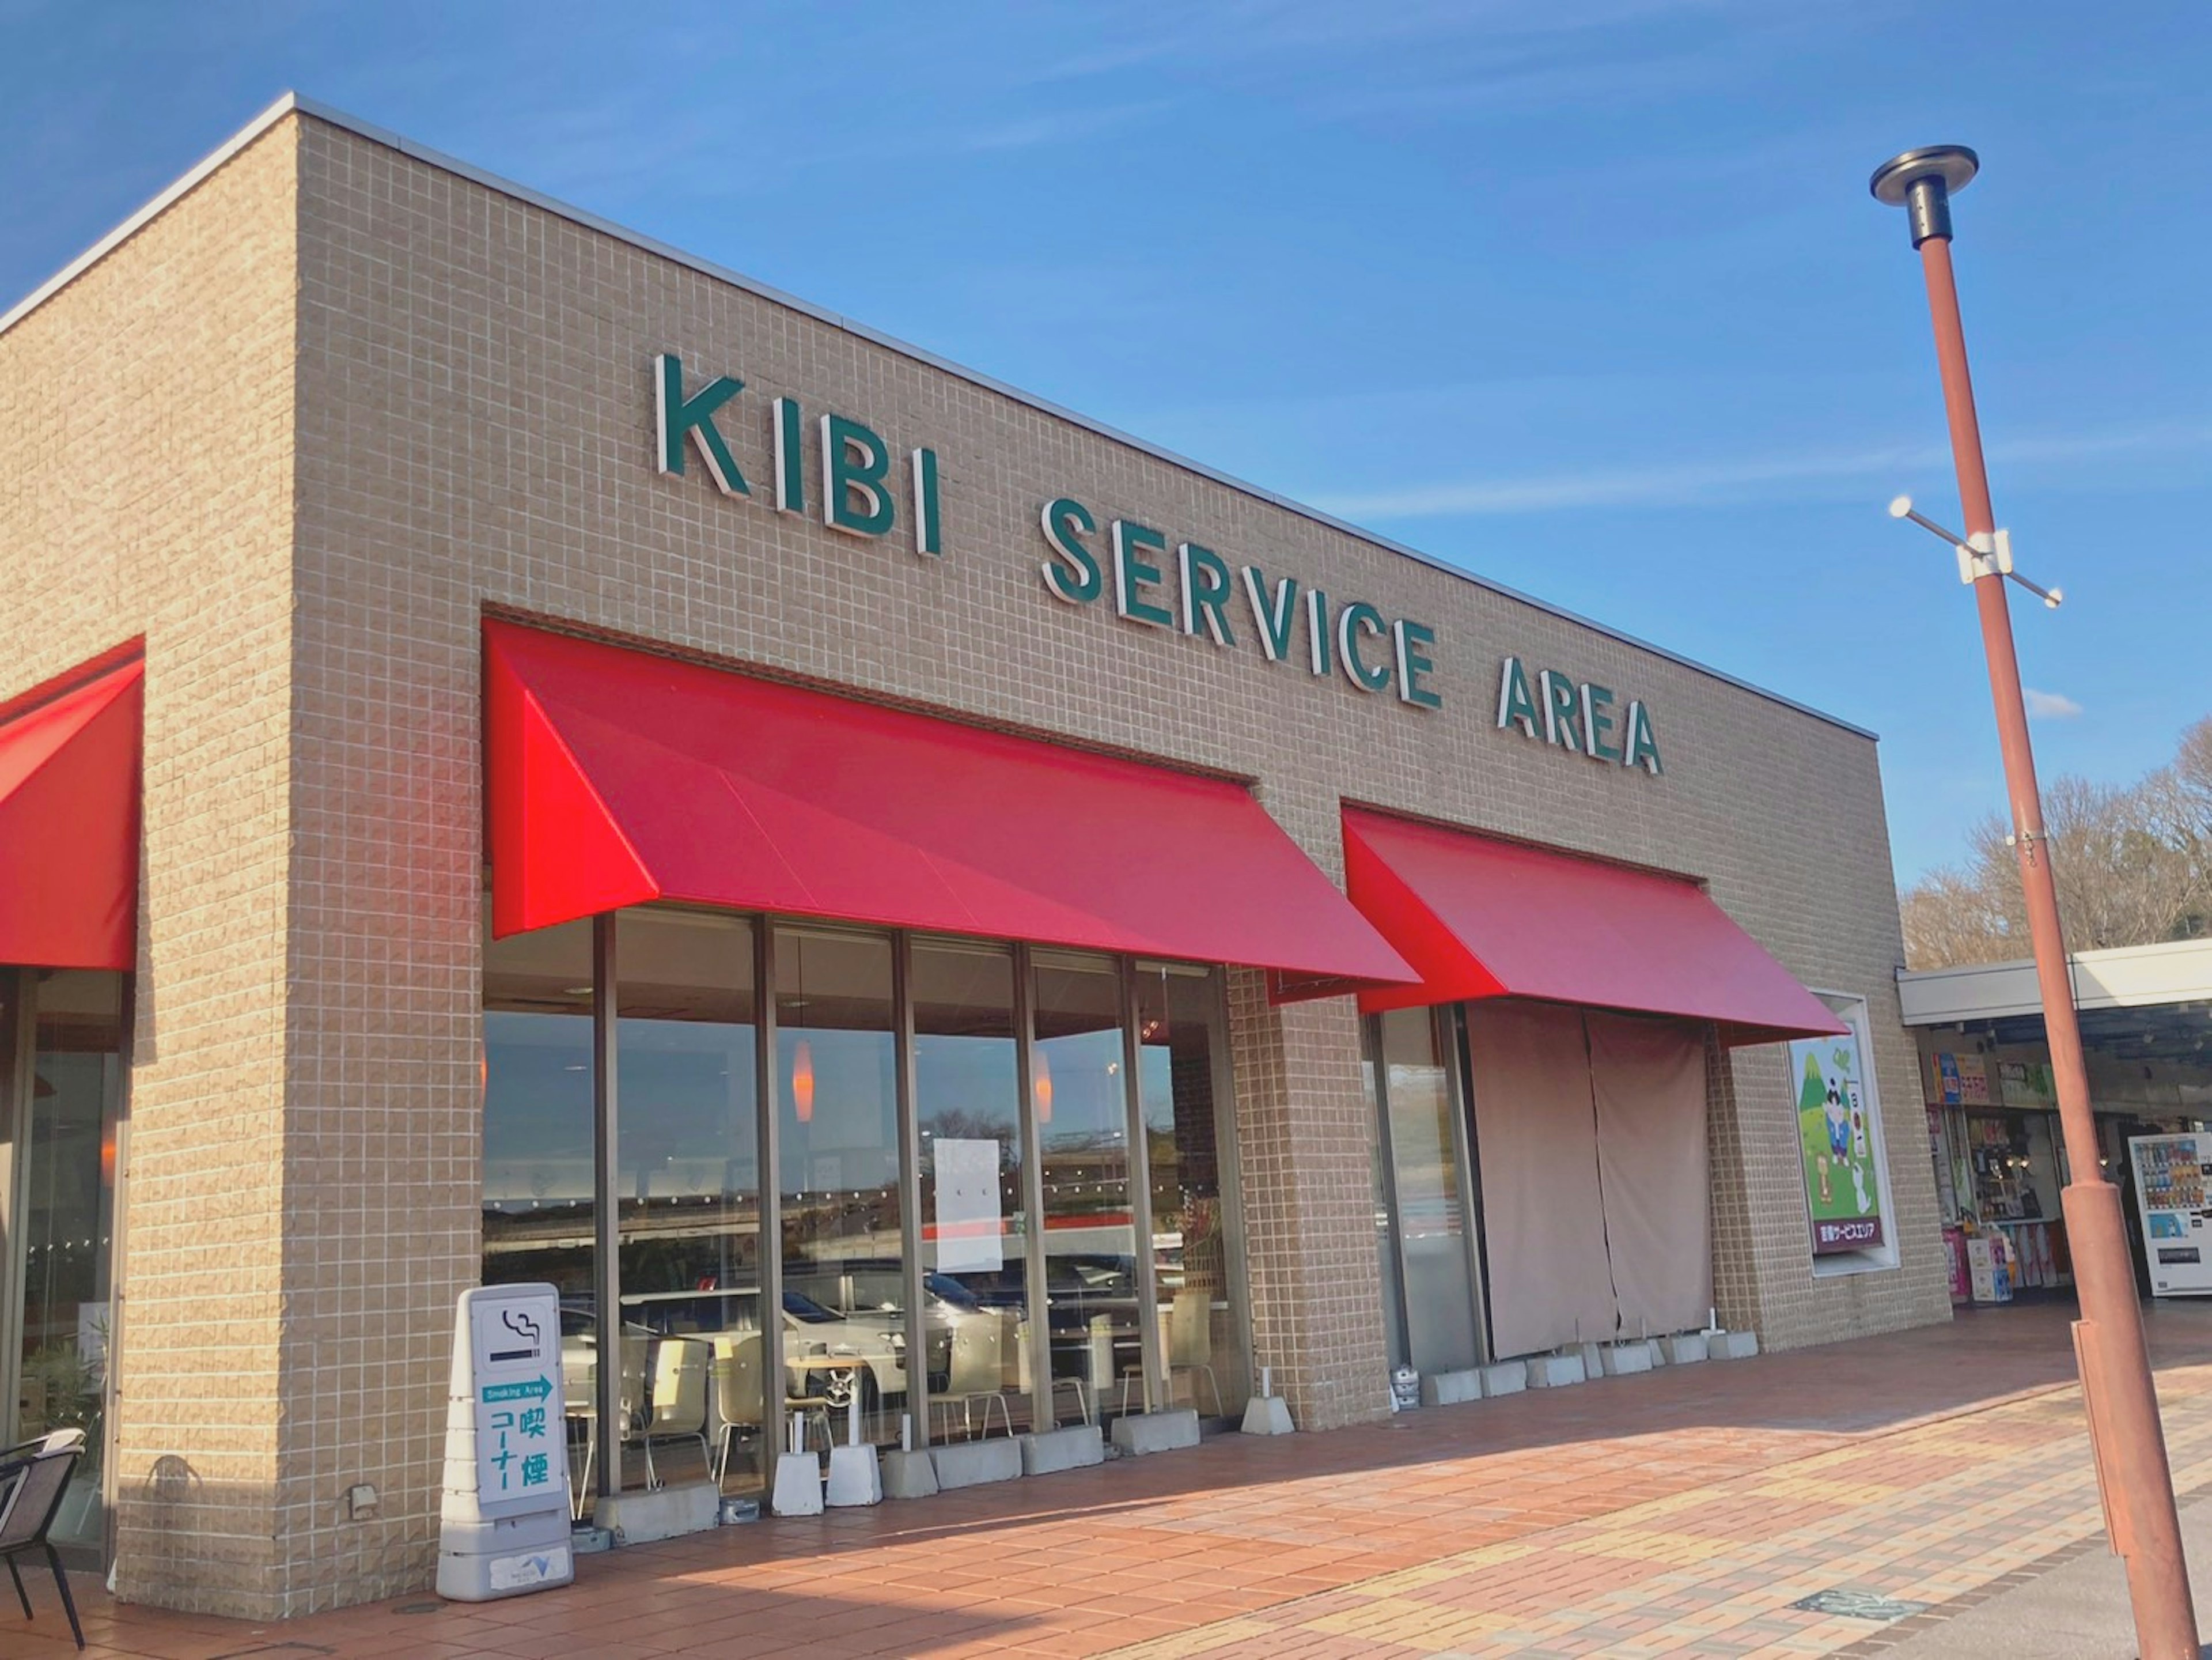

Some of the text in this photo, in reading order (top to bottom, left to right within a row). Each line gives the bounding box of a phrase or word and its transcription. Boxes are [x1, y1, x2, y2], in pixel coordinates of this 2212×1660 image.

[655, 353, 1664, 776] KIBI SERVICE AREA
[487, 1385, 543, 1400] Smoking Area
[491, 1412, 518, 1491] コーナー
[520, 1406, 548, 1487] 喫煙
